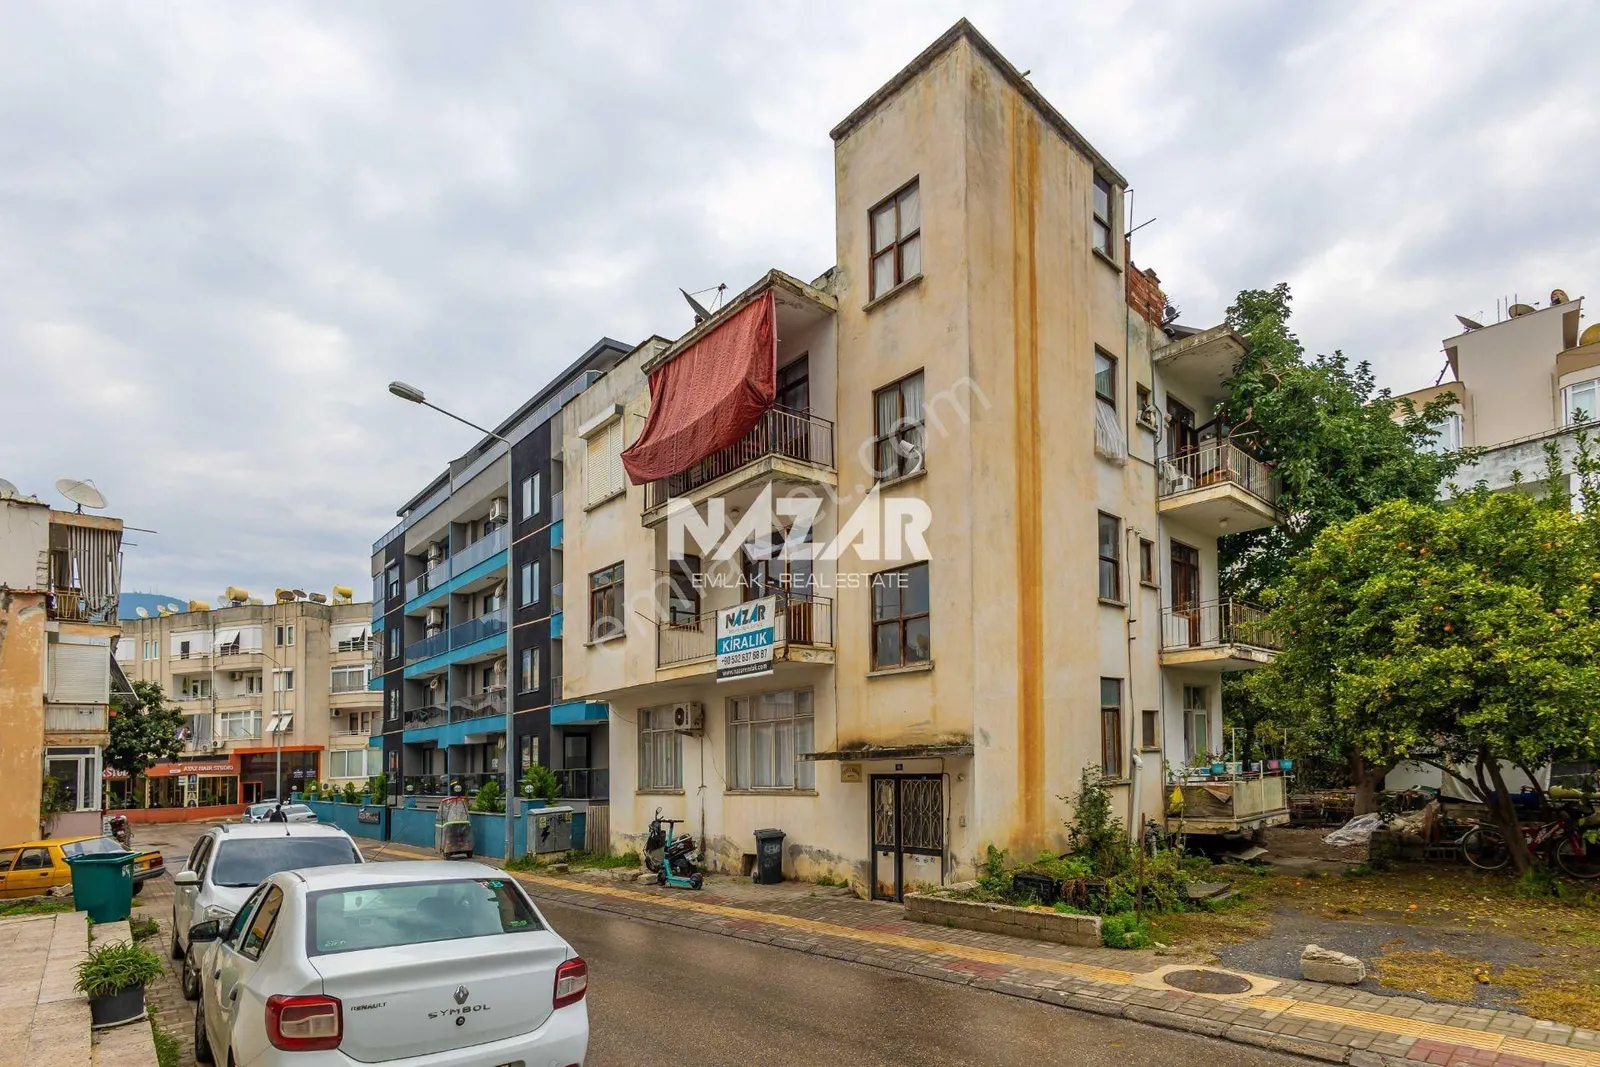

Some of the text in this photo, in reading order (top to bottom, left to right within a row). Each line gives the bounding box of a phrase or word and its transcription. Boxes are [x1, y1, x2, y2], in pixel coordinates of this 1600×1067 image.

[725, 603, 767, 629] NAZAR
[722, 631, 768, 653] KİRALIK
[731, 654, 741, 665] 532
[742, 651, 752, 662] 637
[350, 1001, 387, 1012] RENAULT
[427, 1004, 491, 1020] SYMBOL
